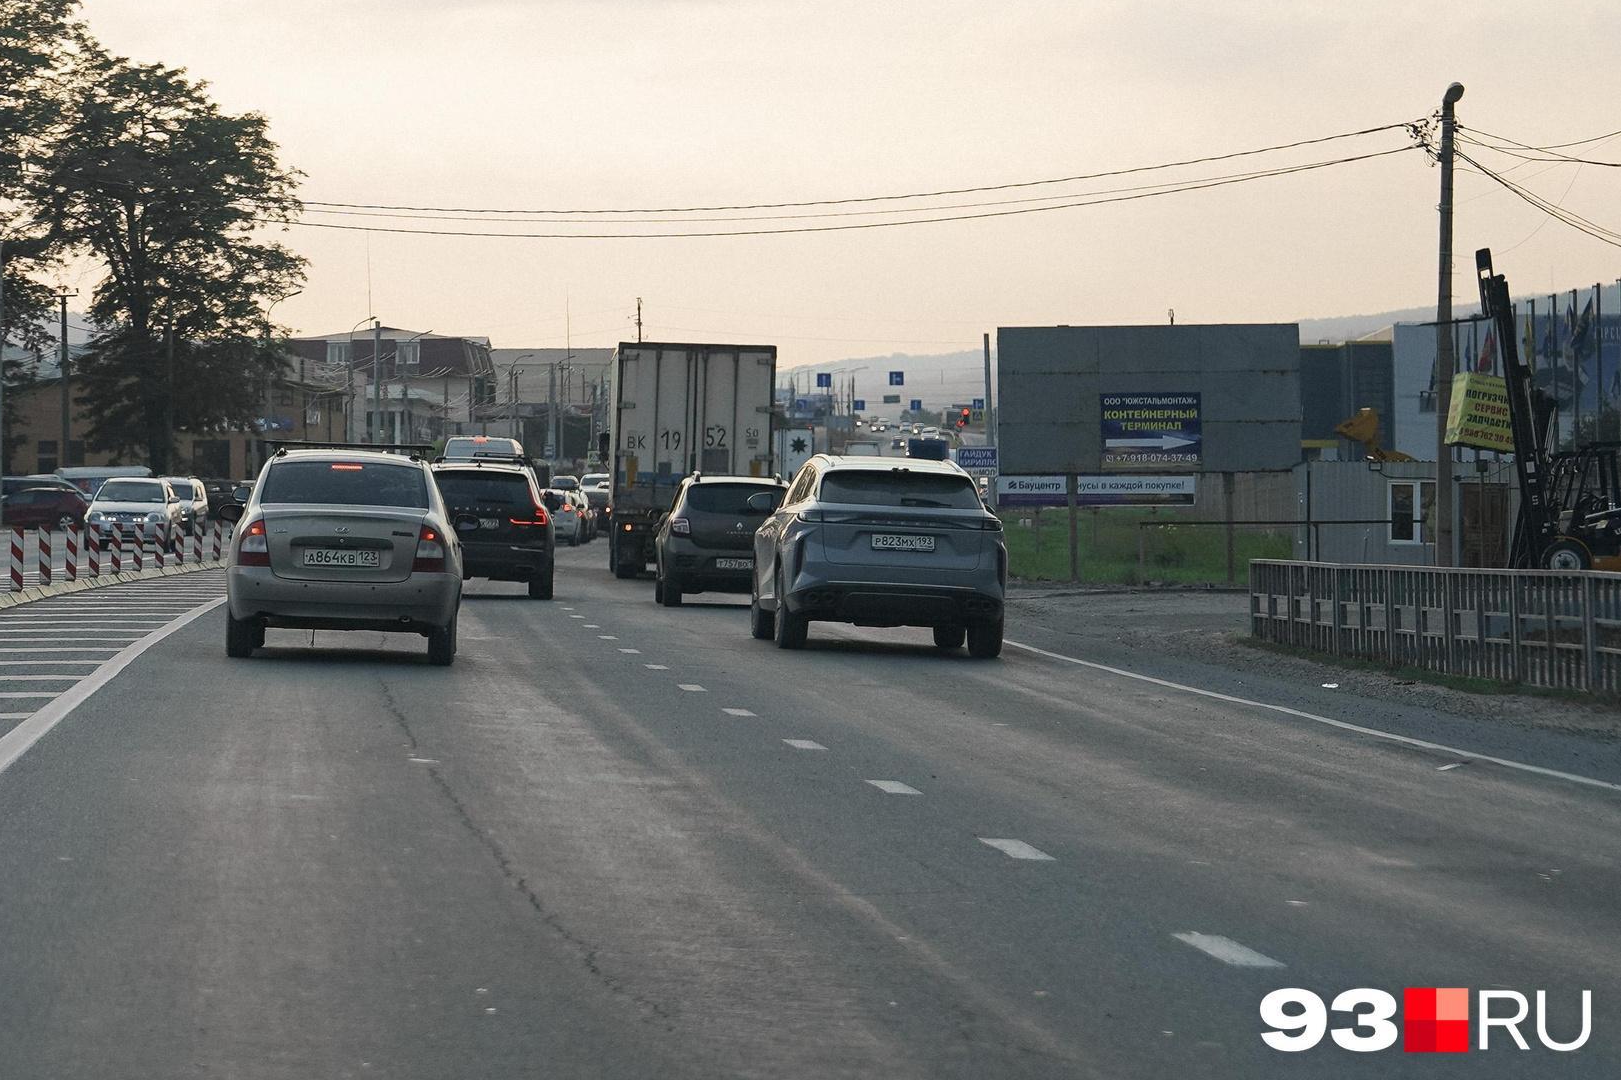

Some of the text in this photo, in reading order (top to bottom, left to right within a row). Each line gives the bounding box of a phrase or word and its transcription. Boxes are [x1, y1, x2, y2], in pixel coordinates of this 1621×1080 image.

[1466, 389, 1509, 404] ПОГРУЗЧИ
[1104, 408, 1197, 419] КОНТЕЙНЕРНЫЙ
[1474, 402, 1508, 416] СЕРВИС
[1121, 421, 1182, 431] ТЕРМИНАЛ
[660, 430, 681, 450] 19
[705, 427, 726, 448] 52
[960, 449, 992, 458] ГАЙДУК
[959, 458, 997, 466] КИРИЛЛО
[1018, 480, 1061, 491] Бауцентр
[1109, 480, 1143, 490] каждой
[1145, 480, 1185, 491] покупке!
[875, 536, 932, 547] Р823МХ 193
[308, 550, 376, 564] А864КВ 123
